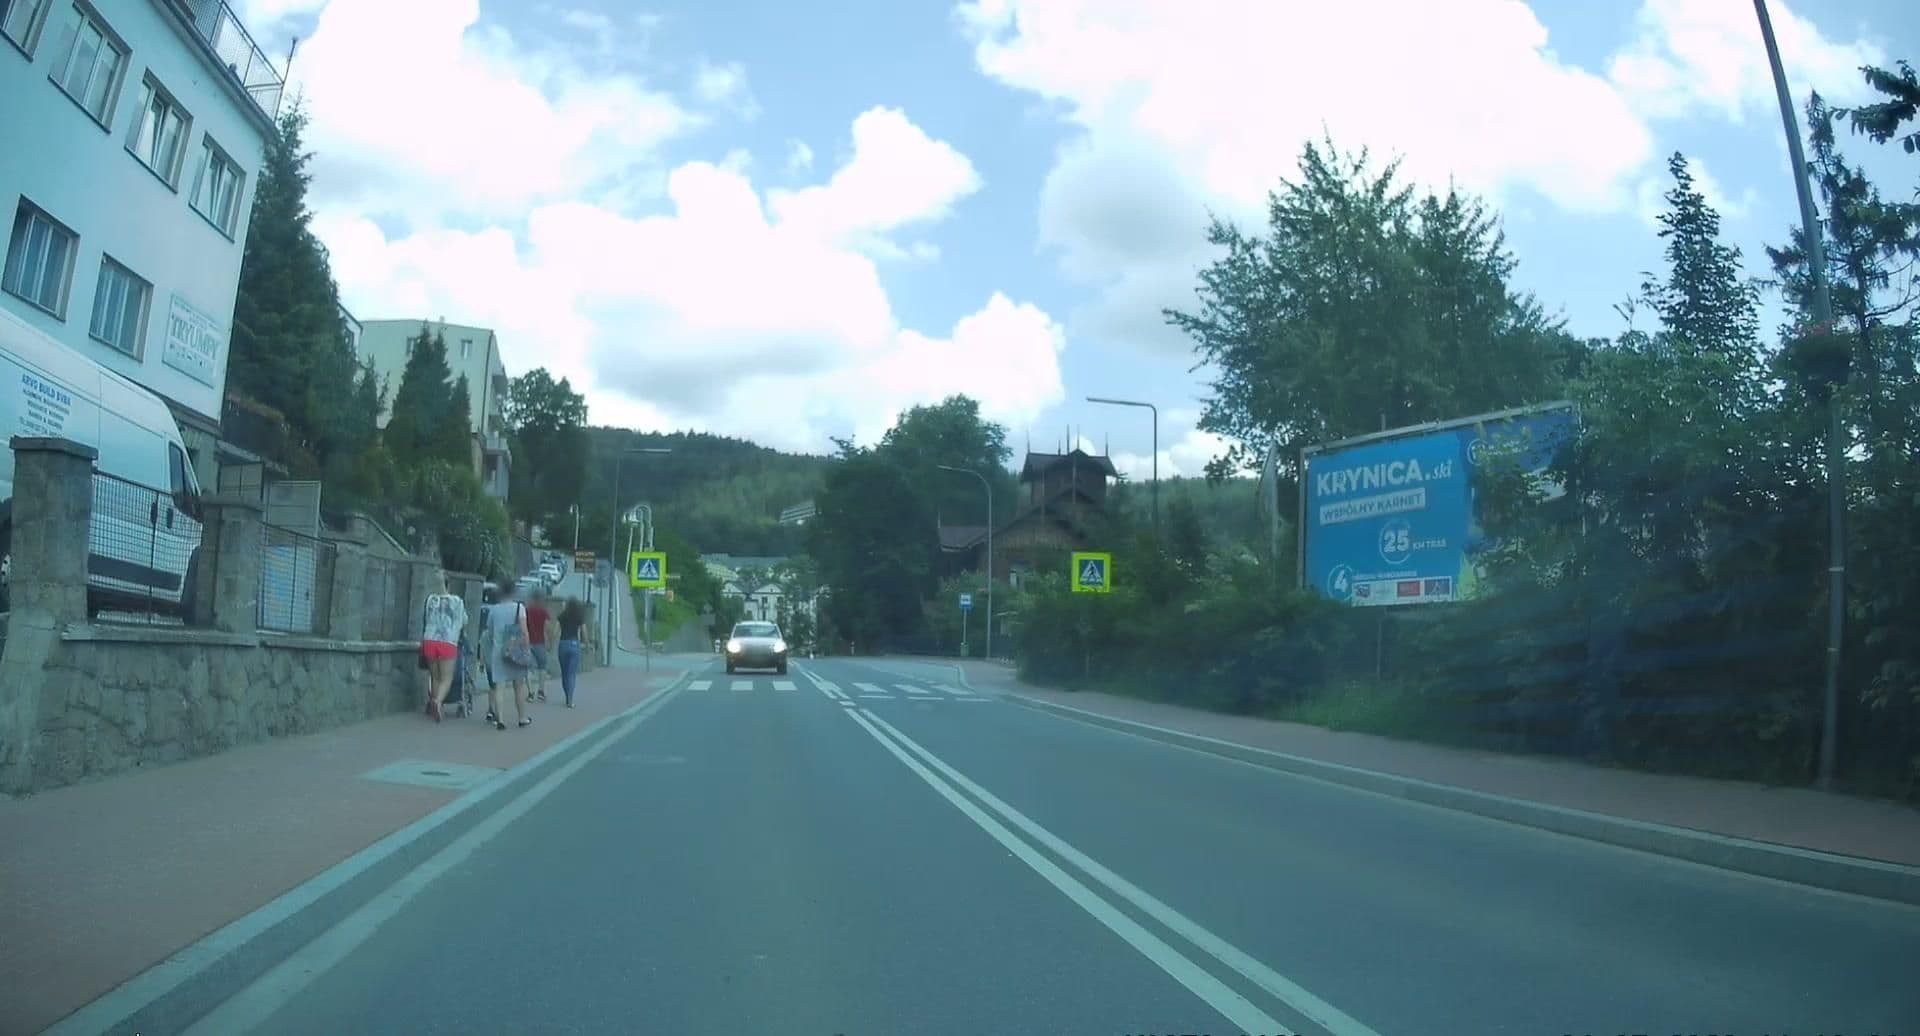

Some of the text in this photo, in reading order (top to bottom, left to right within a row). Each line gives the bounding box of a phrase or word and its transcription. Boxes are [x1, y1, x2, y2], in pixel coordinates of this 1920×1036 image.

[1376, 493, 1421, 514] KARNET
[1384, 530, 1409, 553] 25
[1334, 569, 1348, 593] 4
